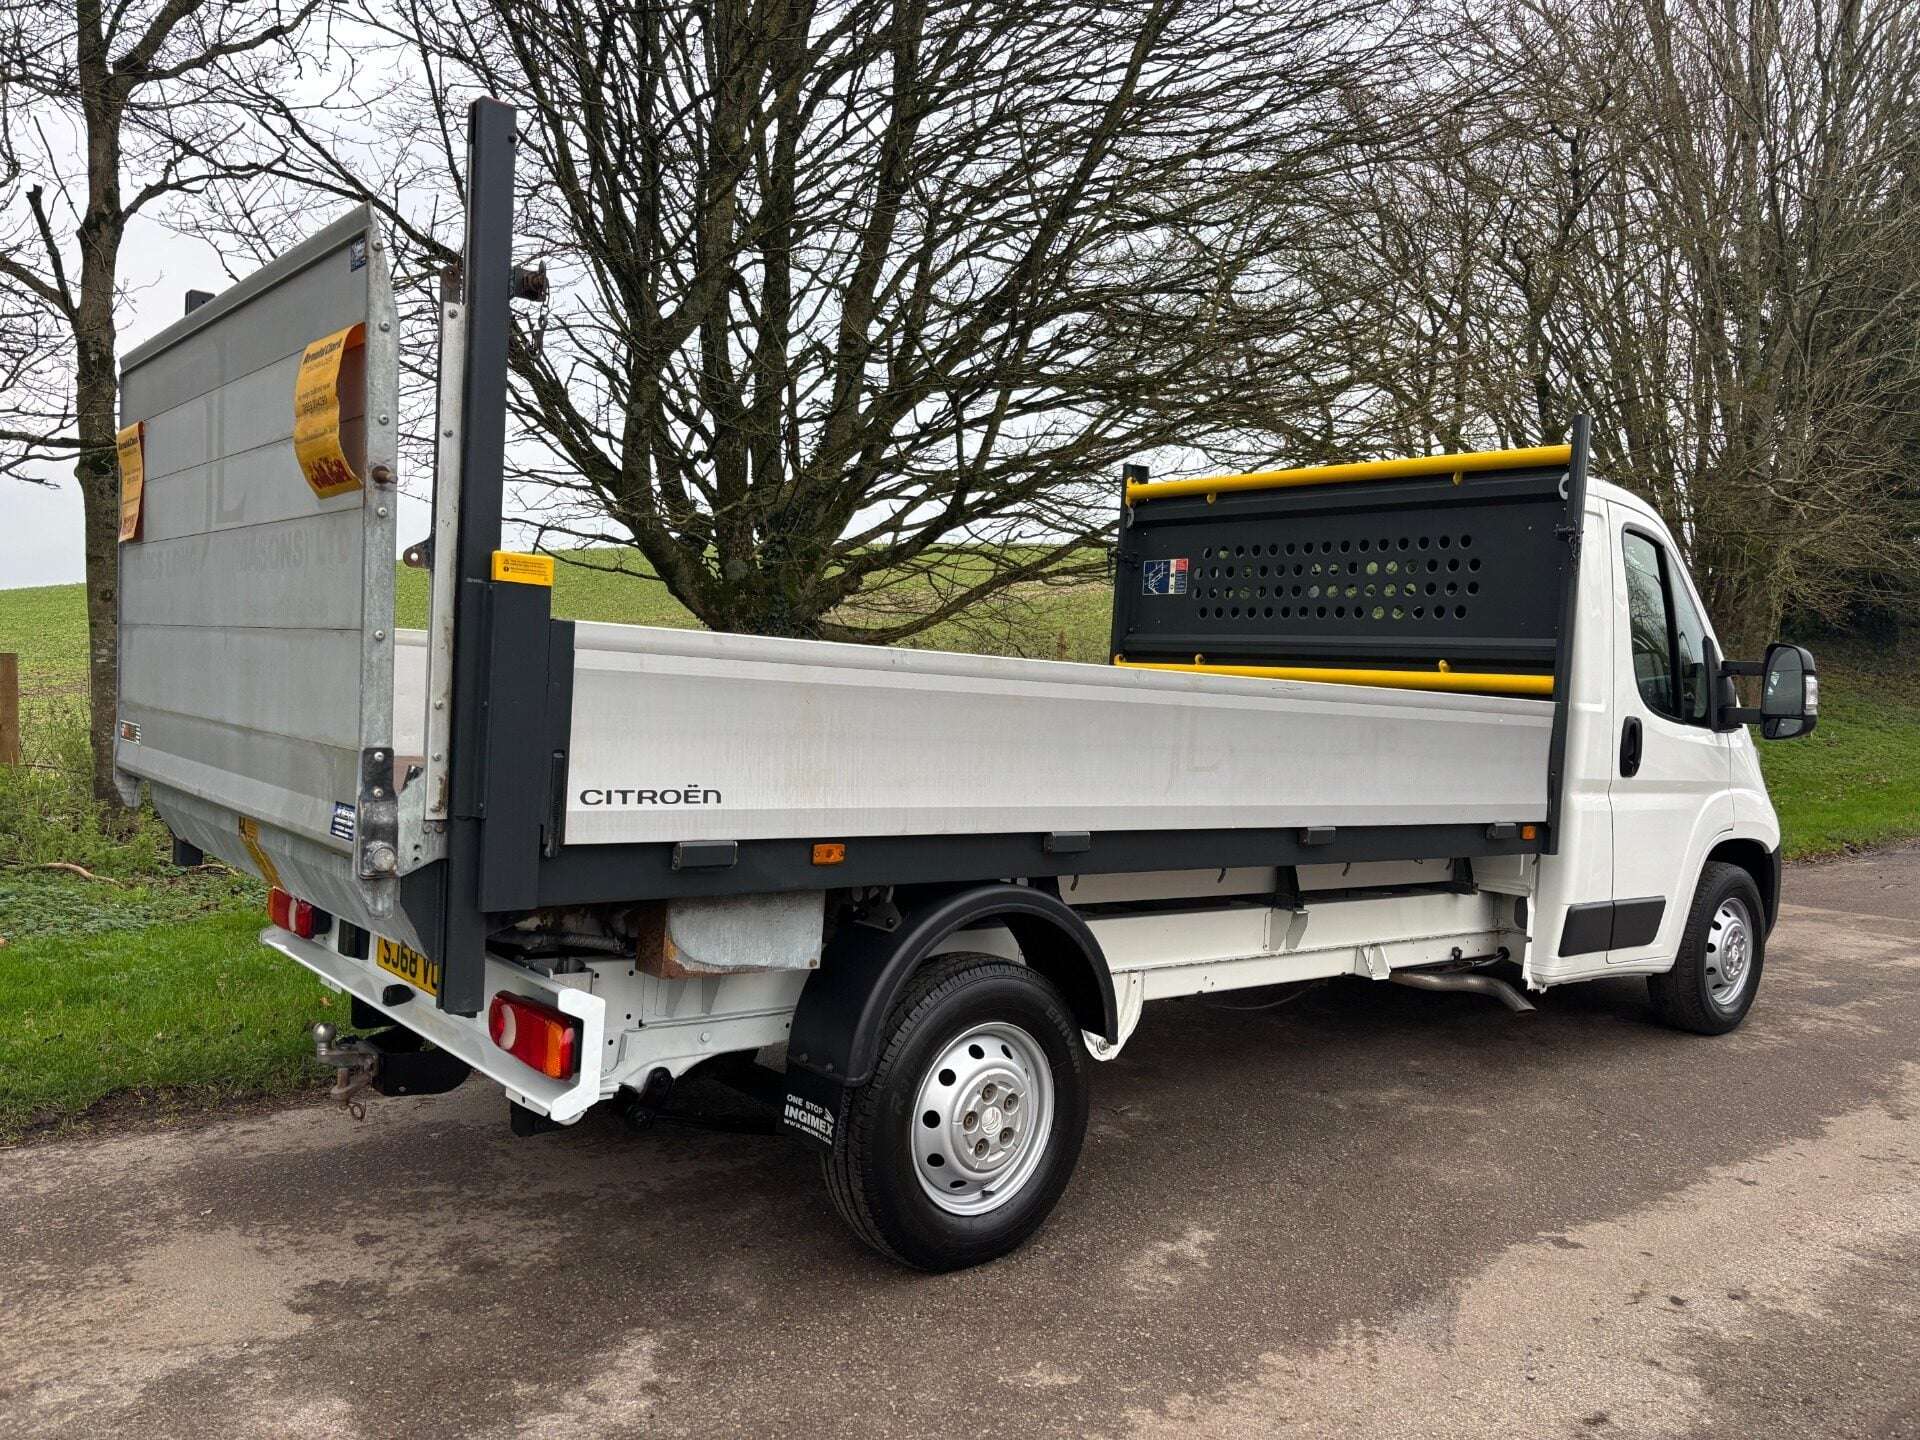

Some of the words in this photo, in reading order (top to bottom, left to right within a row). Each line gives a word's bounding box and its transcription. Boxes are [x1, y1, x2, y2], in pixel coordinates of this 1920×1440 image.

[383, 938, 418, 978] SJ68
[784, 1103, 834, 1138] INGIMEX
[786, 1093, 803, 1107] ONE
[805, 1101, 824, 1115] STOP
